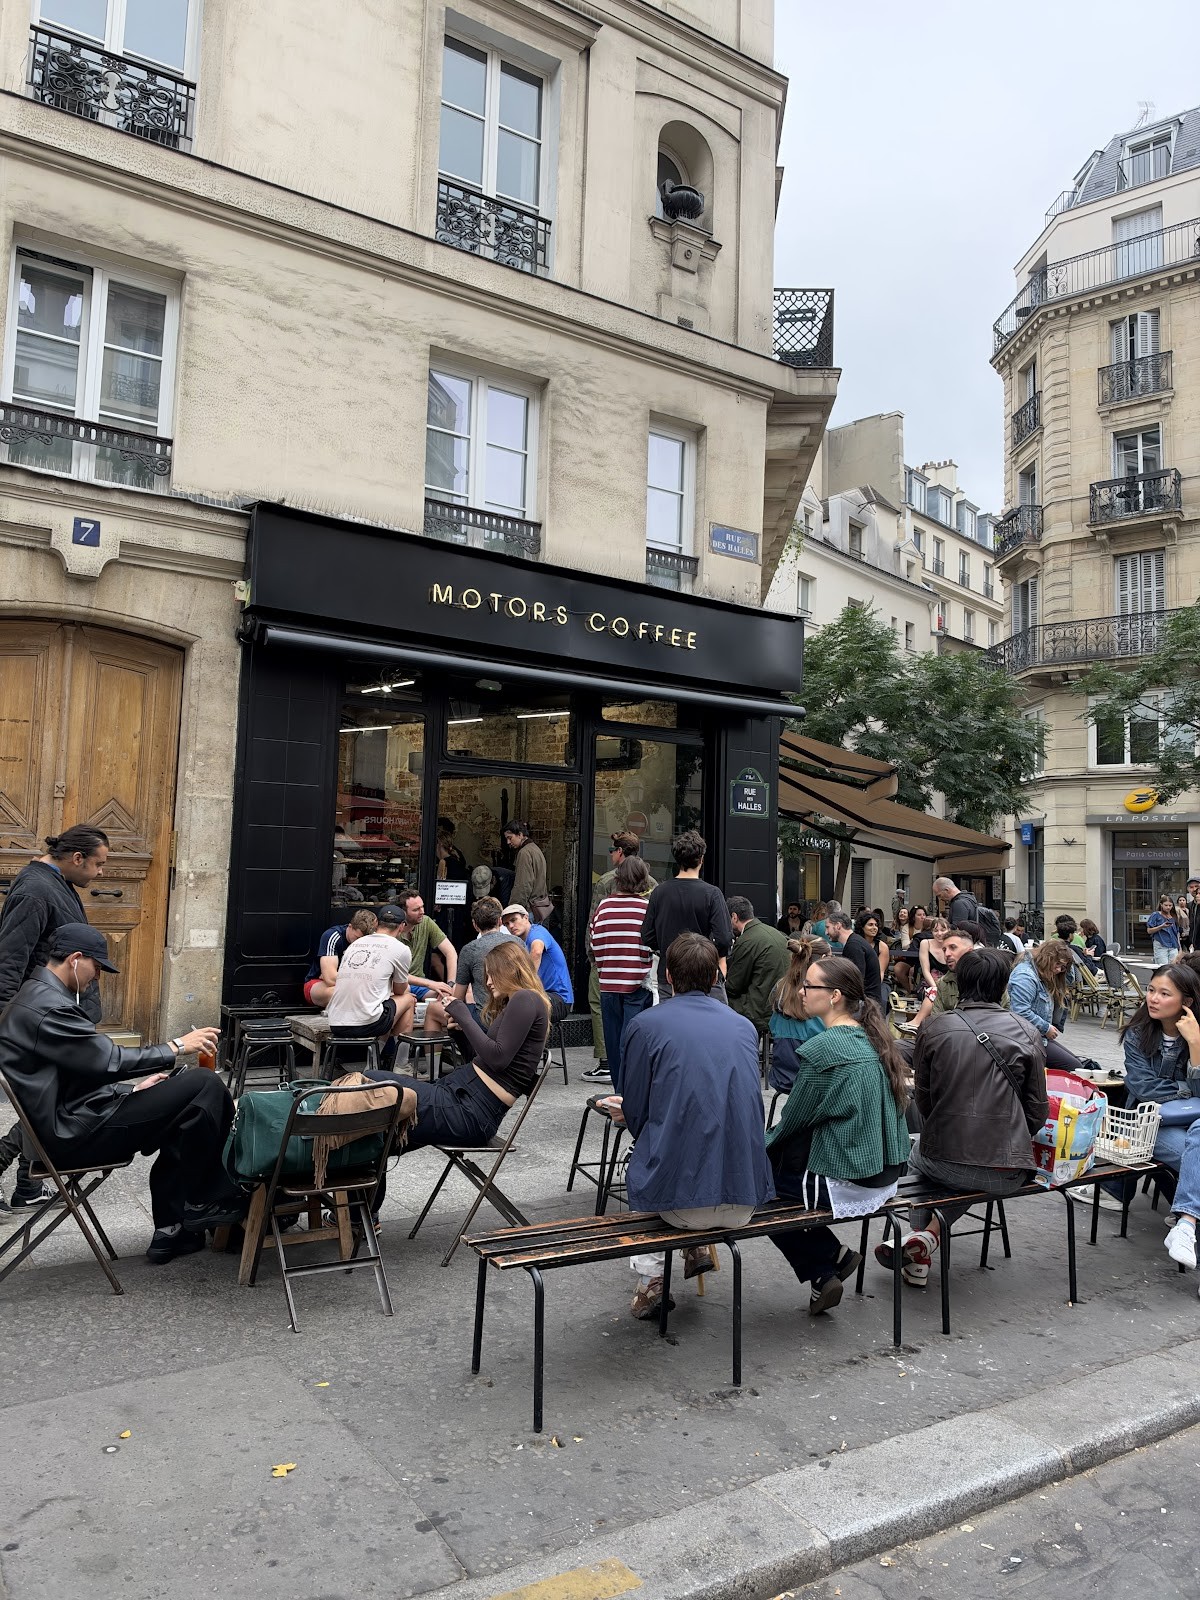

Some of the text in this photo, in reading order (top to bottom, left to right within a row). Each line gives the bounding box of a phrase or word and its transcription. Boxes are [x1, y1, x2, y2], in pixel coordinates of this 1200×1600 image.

[79, 521, 95, 542] 7
[725, 533, 742, 544] RUE
[712, 539, 755, 556] DES HALLES
[432, 583, 697, 650] MOTORS COFFEE
[743, 787, 757, 796] RUE
[737, 801, 762, 811] HALLES
[1131, 814, 1178, 822] POSTE
